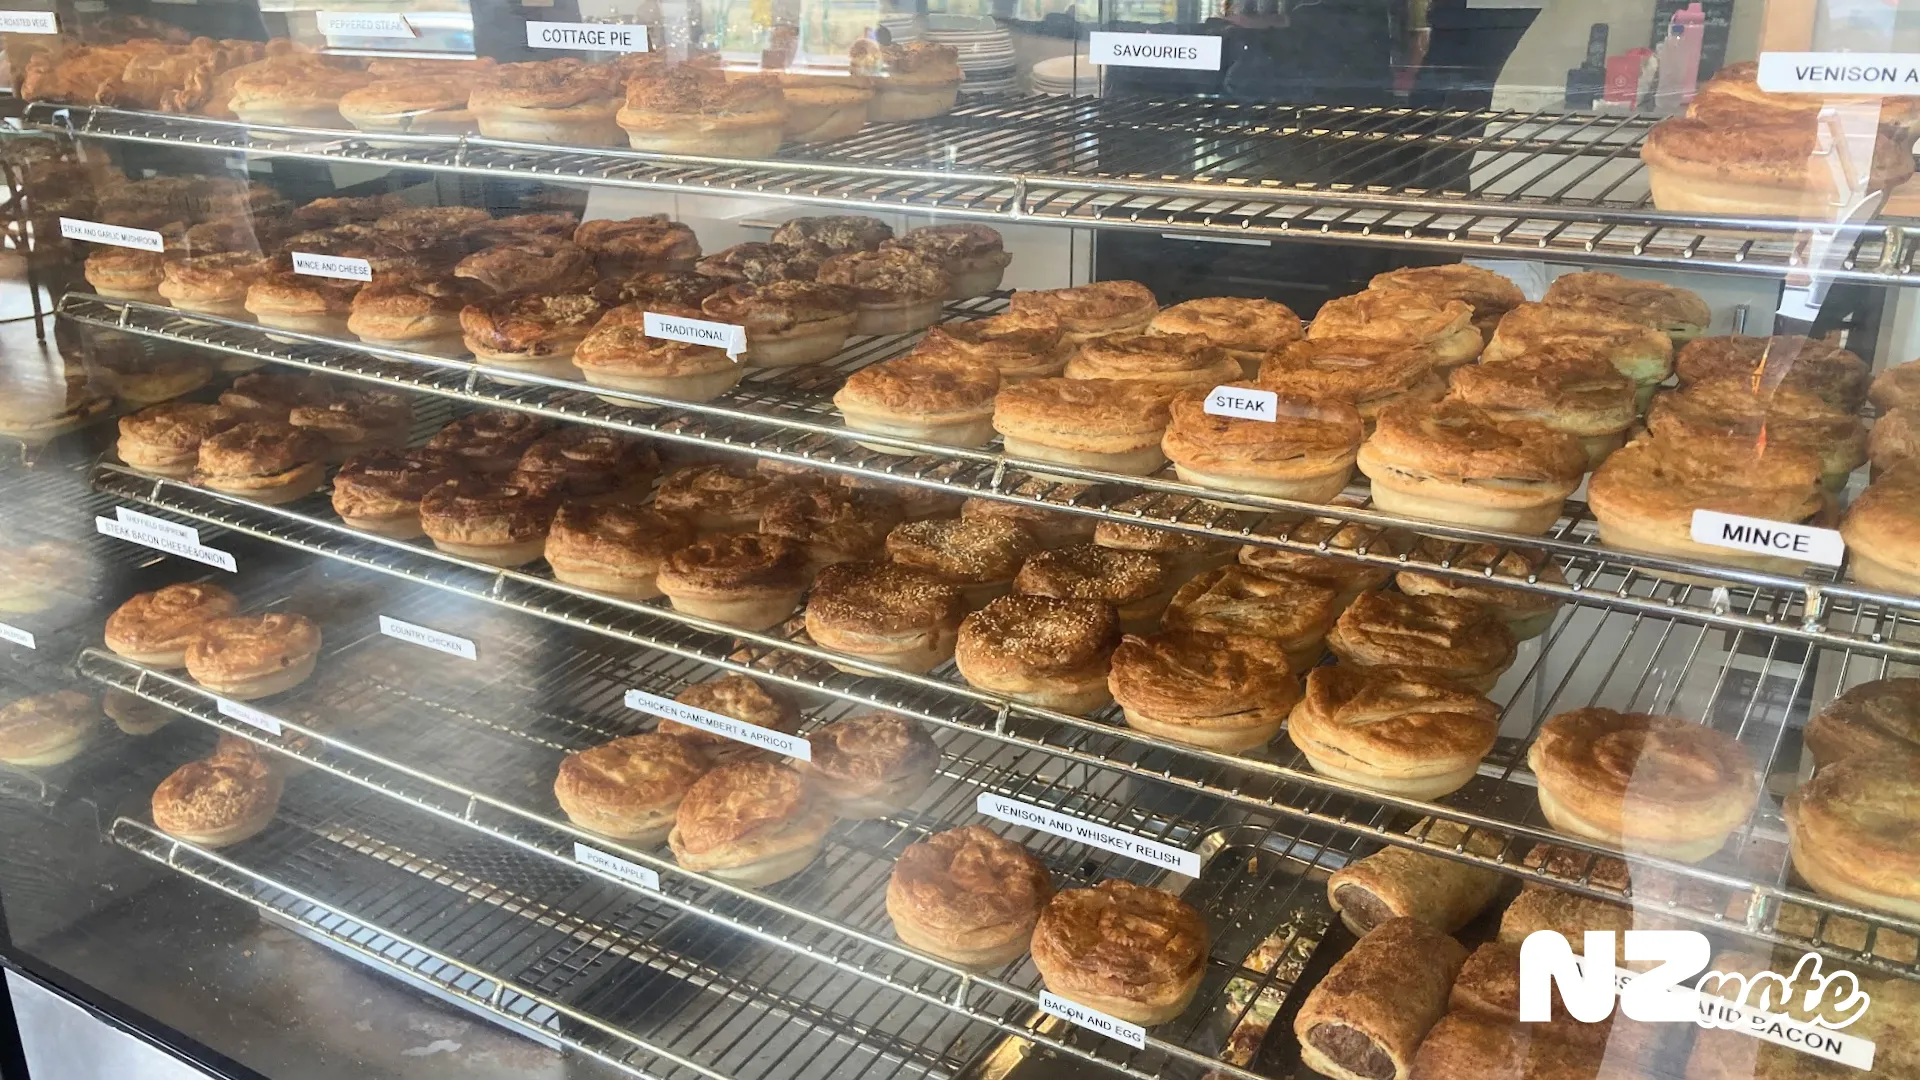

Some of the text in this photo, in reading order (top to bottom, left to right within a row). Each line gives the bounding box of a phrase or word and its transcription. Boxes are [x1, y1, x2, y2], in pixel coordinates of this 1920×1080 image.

[330, 20, 403, 31] PEPPERED STEAK
[542, 28, 632, 46] COTTAGE PIE
[1113, 44, 1198, 60] SAVOURIES
[1795, 66, 1897, 82] VENISON
[63, 224, 158, 245] STEAK AND GARLIC MUSHROOM
[296, 260, 369, 275] MINCE AND CHEESE
[659, 322, 725, 341] TRADITIONAL
[1216, 396, 1265, 412] STEAK
[105, 522, 129, 536] STEAK
[132, 531, 160, 546] BACON
[1722, 523, 1811, 553] MINCE
[390, 624, 462, 651] COUNTRY CHICKEN
[638, 698, 793, 751] CHICKEN CAMEMBERT & APRICOT
[995, 802, 1182, 866] VENISON AND WHISKEY RELISH
[587, 852, 644, 880] PORK & APPLE
[1044, 998, 1141, 1042] BACON AND EGG
